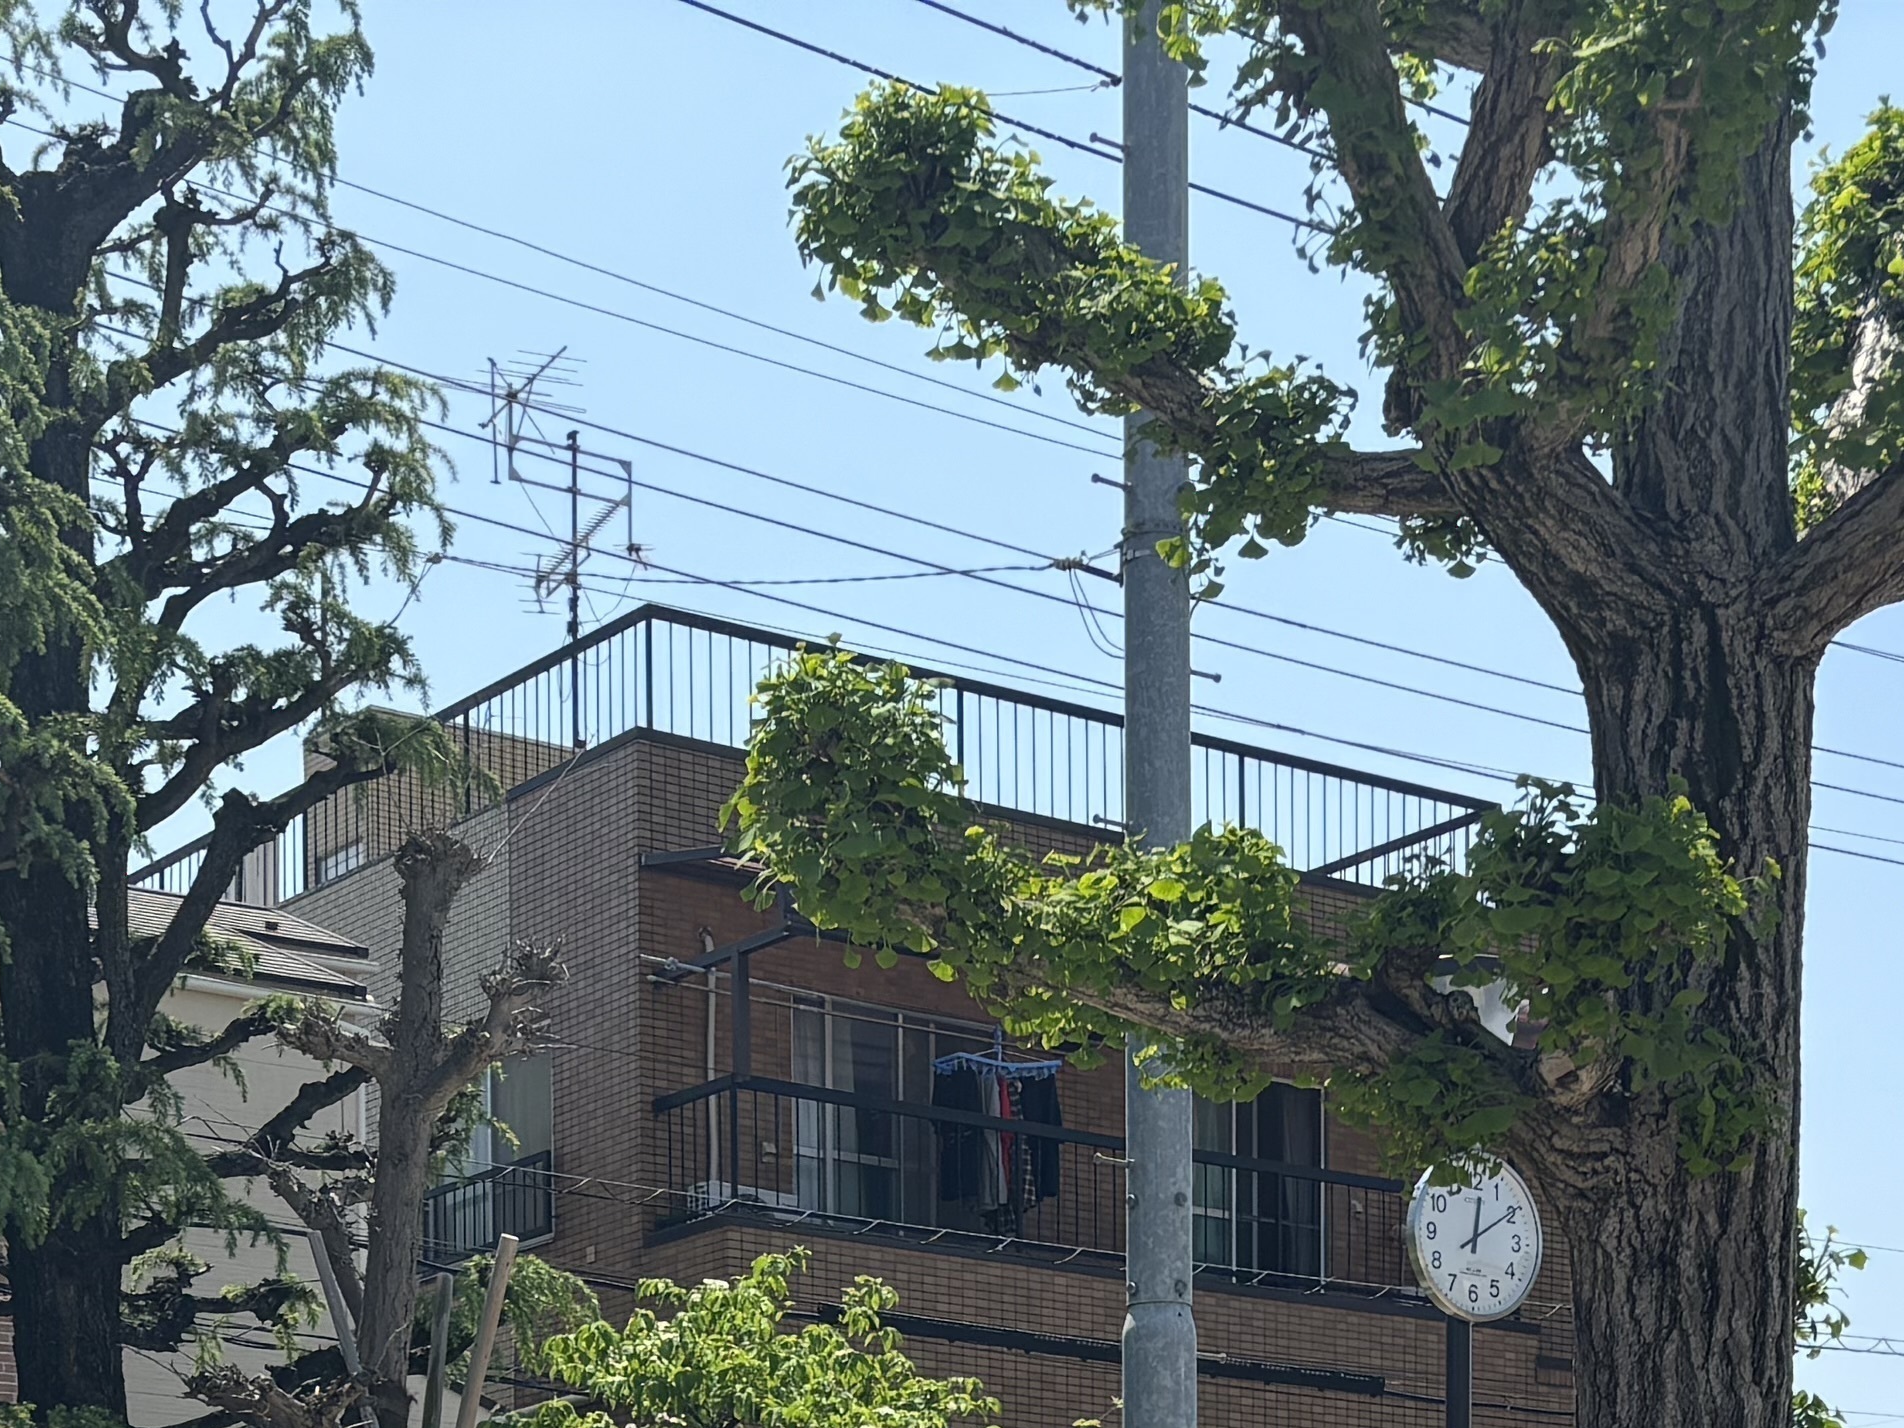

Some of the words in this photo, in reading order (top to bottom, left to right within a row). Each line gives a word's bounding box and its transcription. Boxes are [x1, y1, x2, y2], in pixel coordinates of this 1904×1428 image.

[1494, 1183, 1499, 1201] 1
[1430, 1193, 1447, 1213] 10
[1506, 1205, 1516, 1224] 2
[1426, 1221, 1437, 1240] 9
[1511, 1234, 1521, 1253] 3
[1431, 1250, 1441, 1269] 8
[1504, 1262, 1515, 1280] 4
[1448, 1273, 1457, 1292] 7
[1489, 1279, 1500, 1298] 5
[1468, 1284, 1478, 1303] 6
